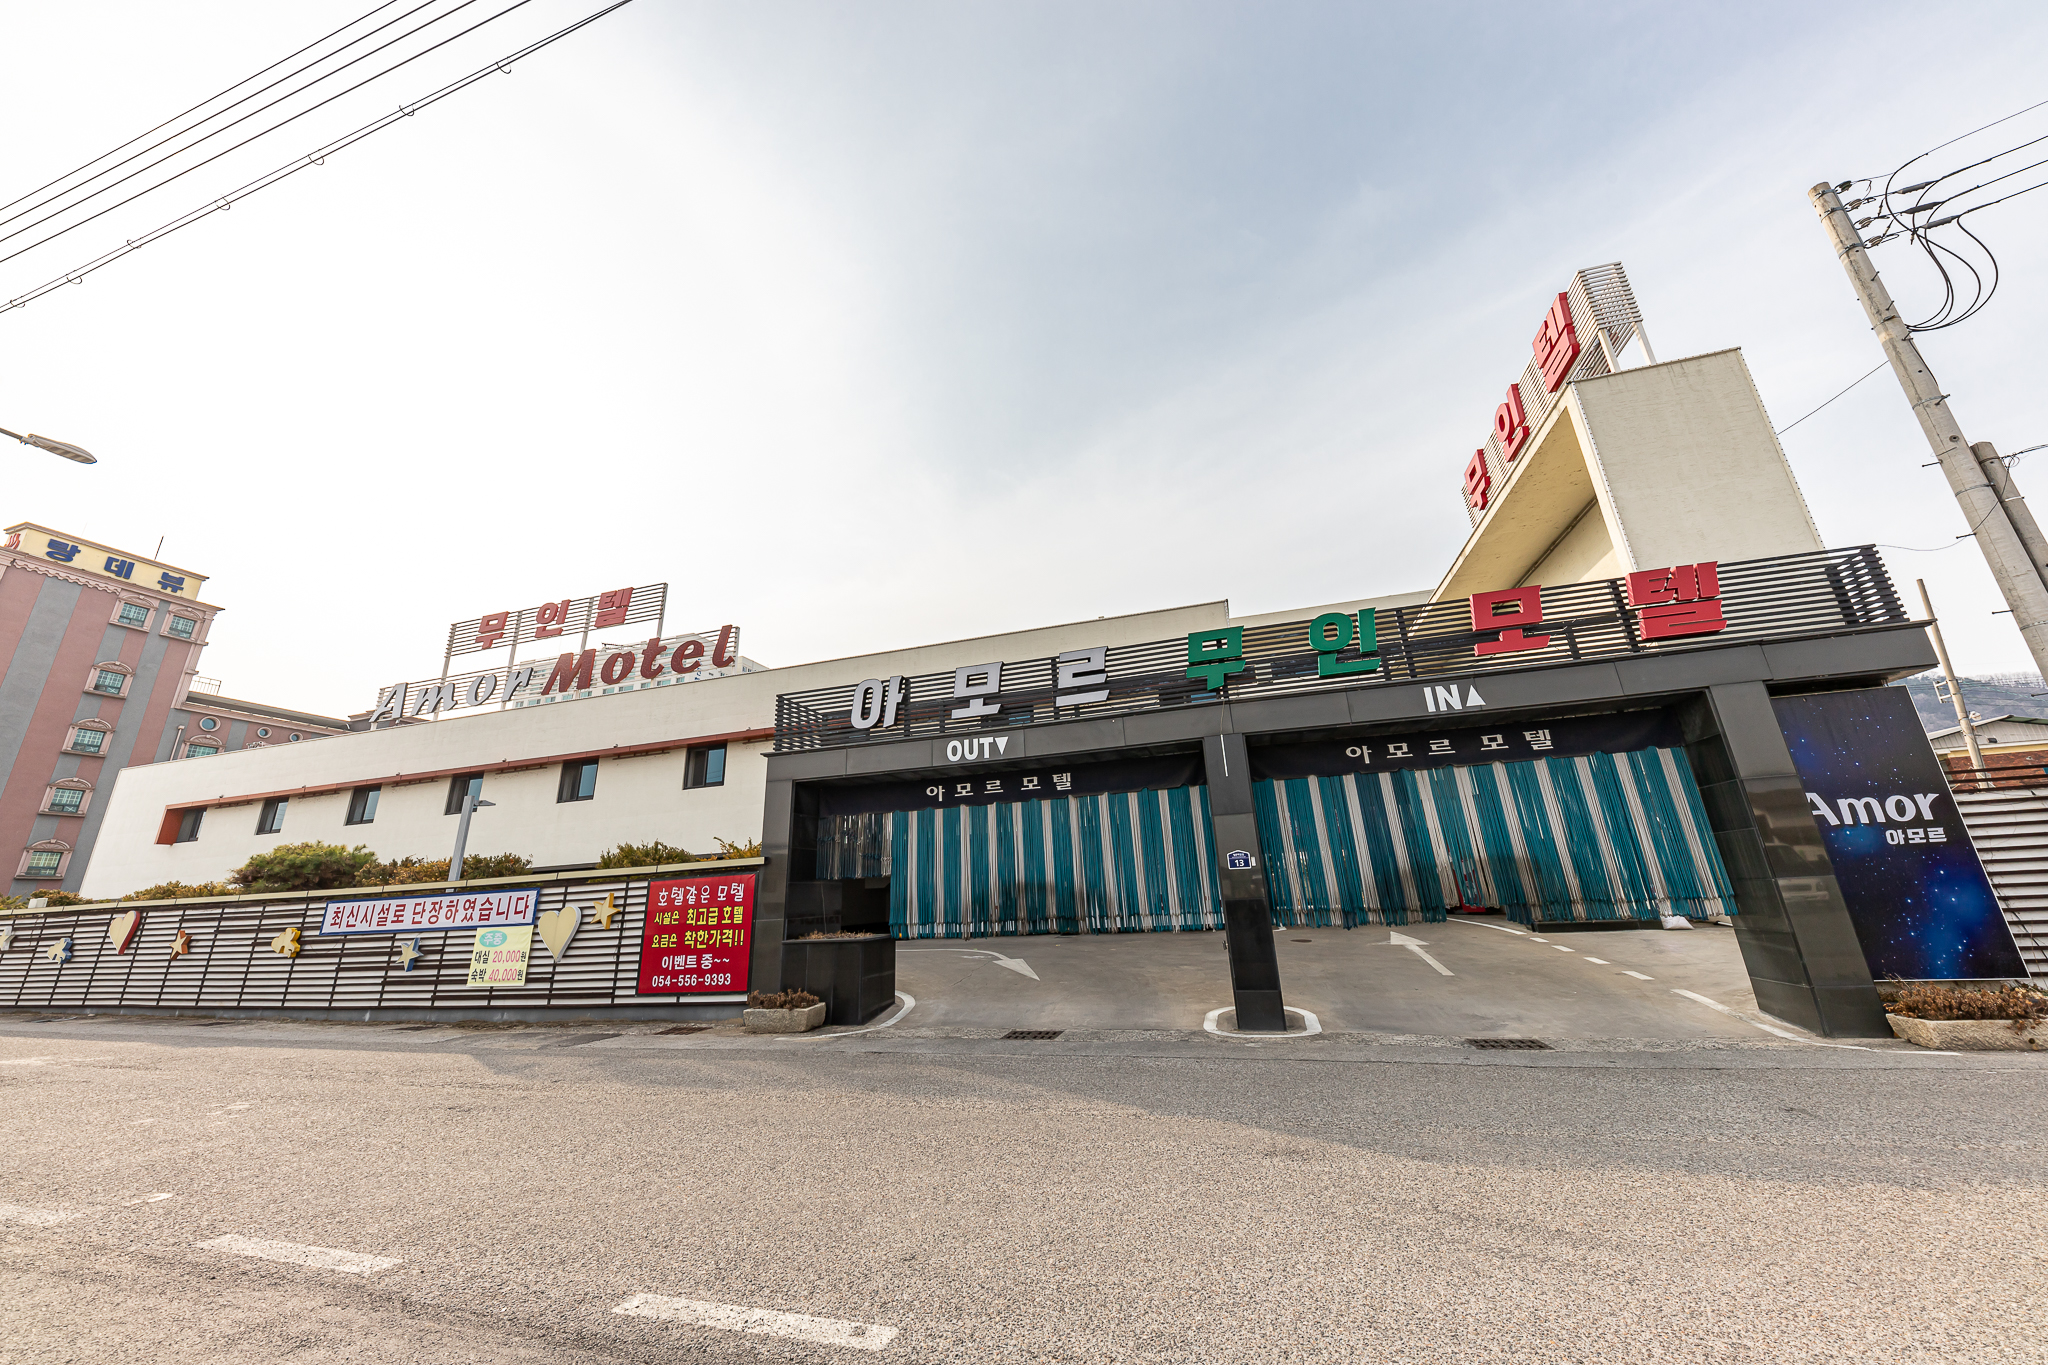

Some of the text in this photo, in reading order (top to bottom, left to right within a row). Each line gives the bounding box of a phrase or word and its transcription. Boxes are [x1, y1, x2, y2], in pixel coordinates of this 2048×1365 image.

[45, 538, 185, 593] 랑데뷰
[475, 586, 634, 649] 무인텔
[369, 624, 735, 723] Amor Motel
[850, 645, 1110, 730] 아모르
[1423, 684, 1463, 712] IN
[946, 736, 994, 762] OUT
[1345, 729, 1554, 764] 아모르 모텔
[926, 772, 1072, 802] 아모르 모텔
[1805, 792, 1940, 826] Amor
[1885, 827, 1947, 845] 아모르
[1234, 859, 1245, 867] 13
[717, 883, 745, 902] 모텔
[330, 894, 530, 928] 최신시설로 단장하였습니다
[654, 906, 744, 926] 시설은 최고급 호텔
[483, 932, 503, 945] 주중
[651, 933, 678, 948] 요금은
[474, 950, 490, 964] 대실
[661, 954, 697, 970] 이벤트
[471, 968, 487, 982] 숙박
[652, 973, 731, 987] 054-556-9393
